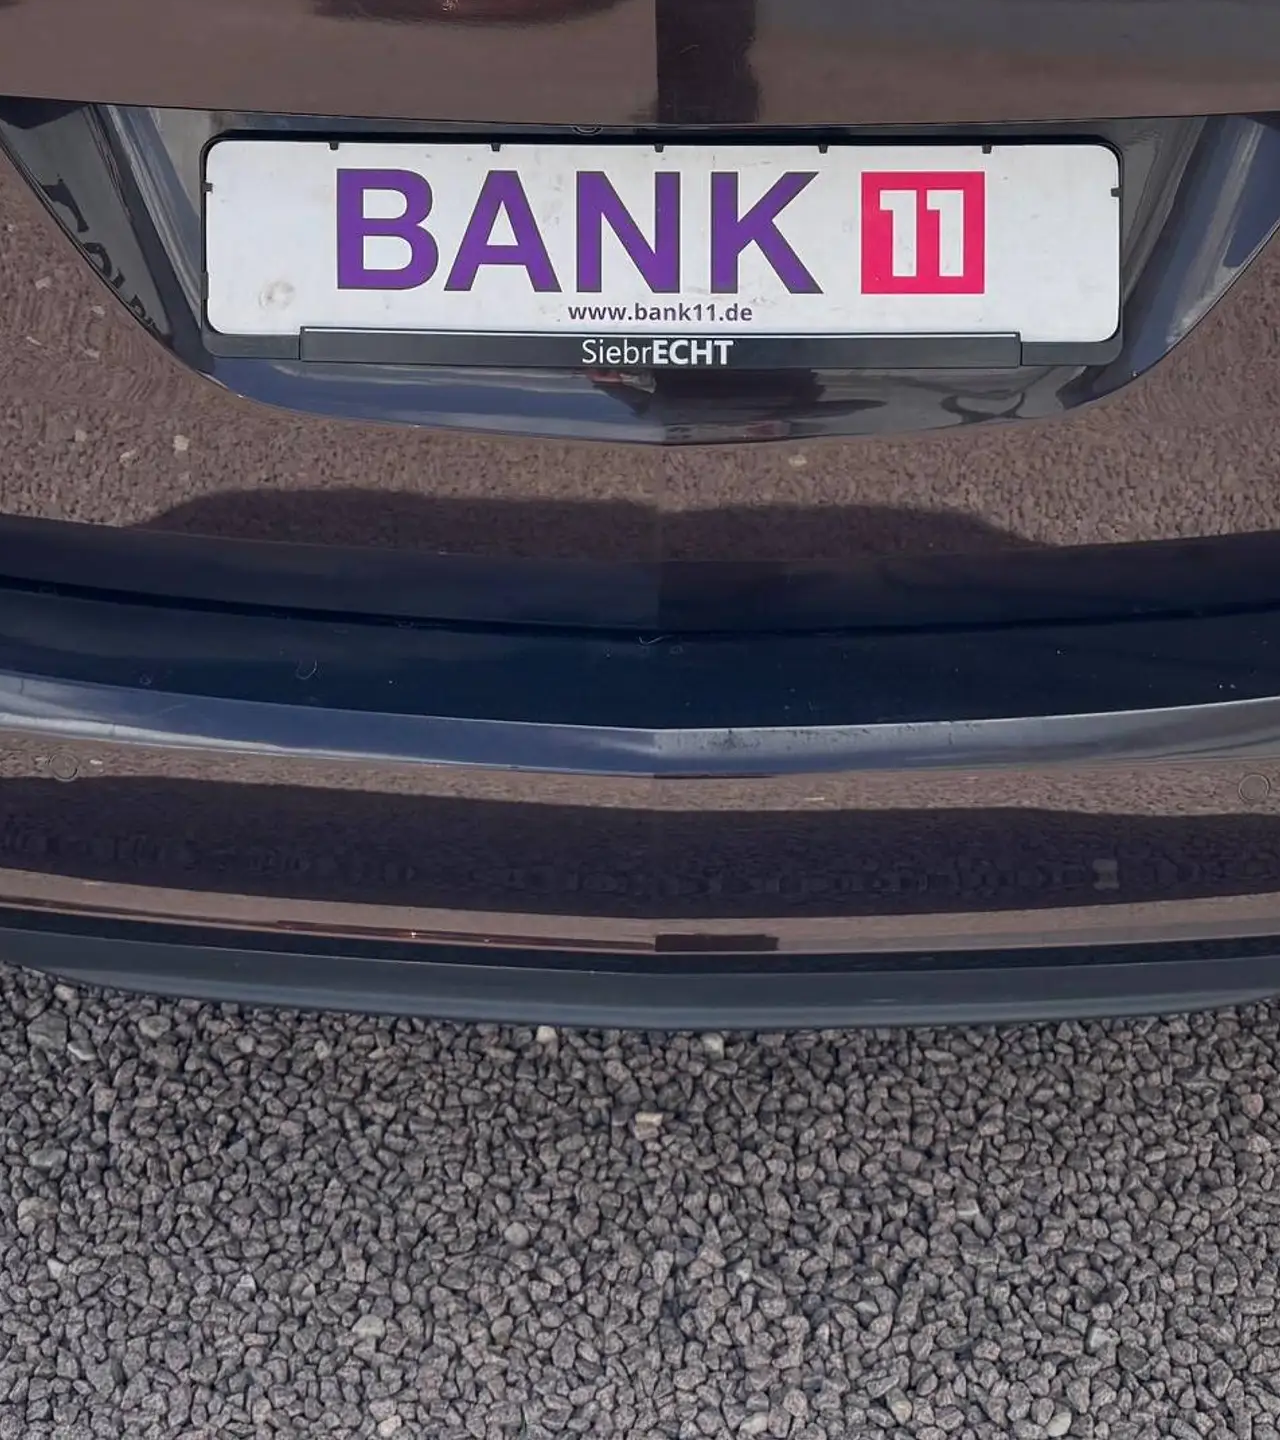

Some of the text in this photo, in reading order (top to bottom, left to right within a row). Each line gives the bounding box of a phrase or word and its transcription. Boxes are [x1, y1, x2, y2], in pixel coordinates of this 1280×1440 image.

[336, 168, 965, 295] BANK 11
[568, 302, 753, 321] www.bank11.de
[582, 339, 734, 365] SiebrECHT
